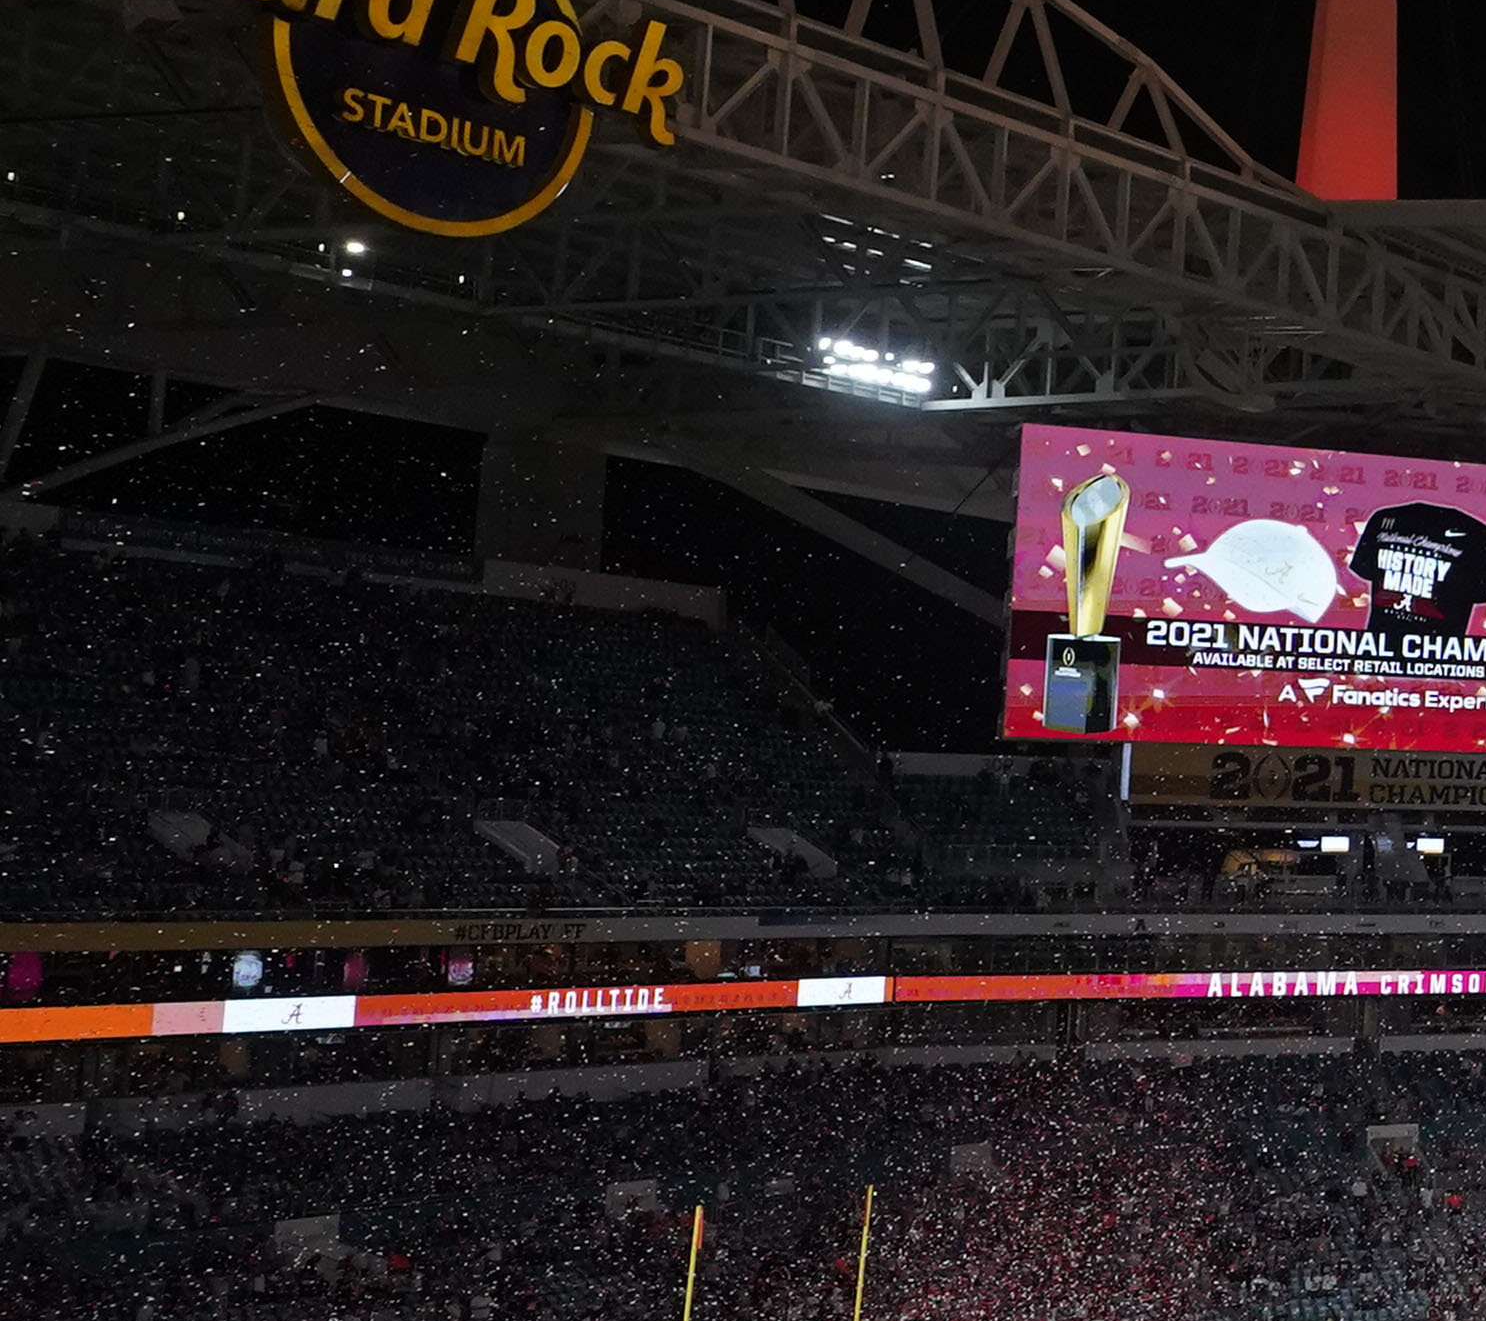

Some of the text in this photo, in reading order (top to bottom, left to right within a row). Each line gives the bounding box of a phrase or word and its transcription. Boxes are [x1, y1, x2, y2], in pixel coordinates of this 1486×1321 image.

[341, 86, 526, 167] STADIUM
[1377, 548, 1452, 581] HISTORY
[1383, 569, 1436, 599] MADE
[1146, 620, 1229, 648] 2021
[1238, 624, 1394, 658] NATIONAL
[1193, 652, 1274, 669] AVAILABLE
[1276, 656, 1295, 669] AT
[1298, 656, 1352, 672] SELECT
[1354, 660, 1403, 674] RETAIL
[1406, 663, 1485, 678] LOCATIONS
[1278, 684, 1297, 702] A
[1332, 684, 1421, 708] Fanatics
[455, 924, 586, 941] #CFBPLAYFF
[1206, 972, 1360, 998] ALABAMA
[529, 987, 665, 1017] #ROLLTIDE
